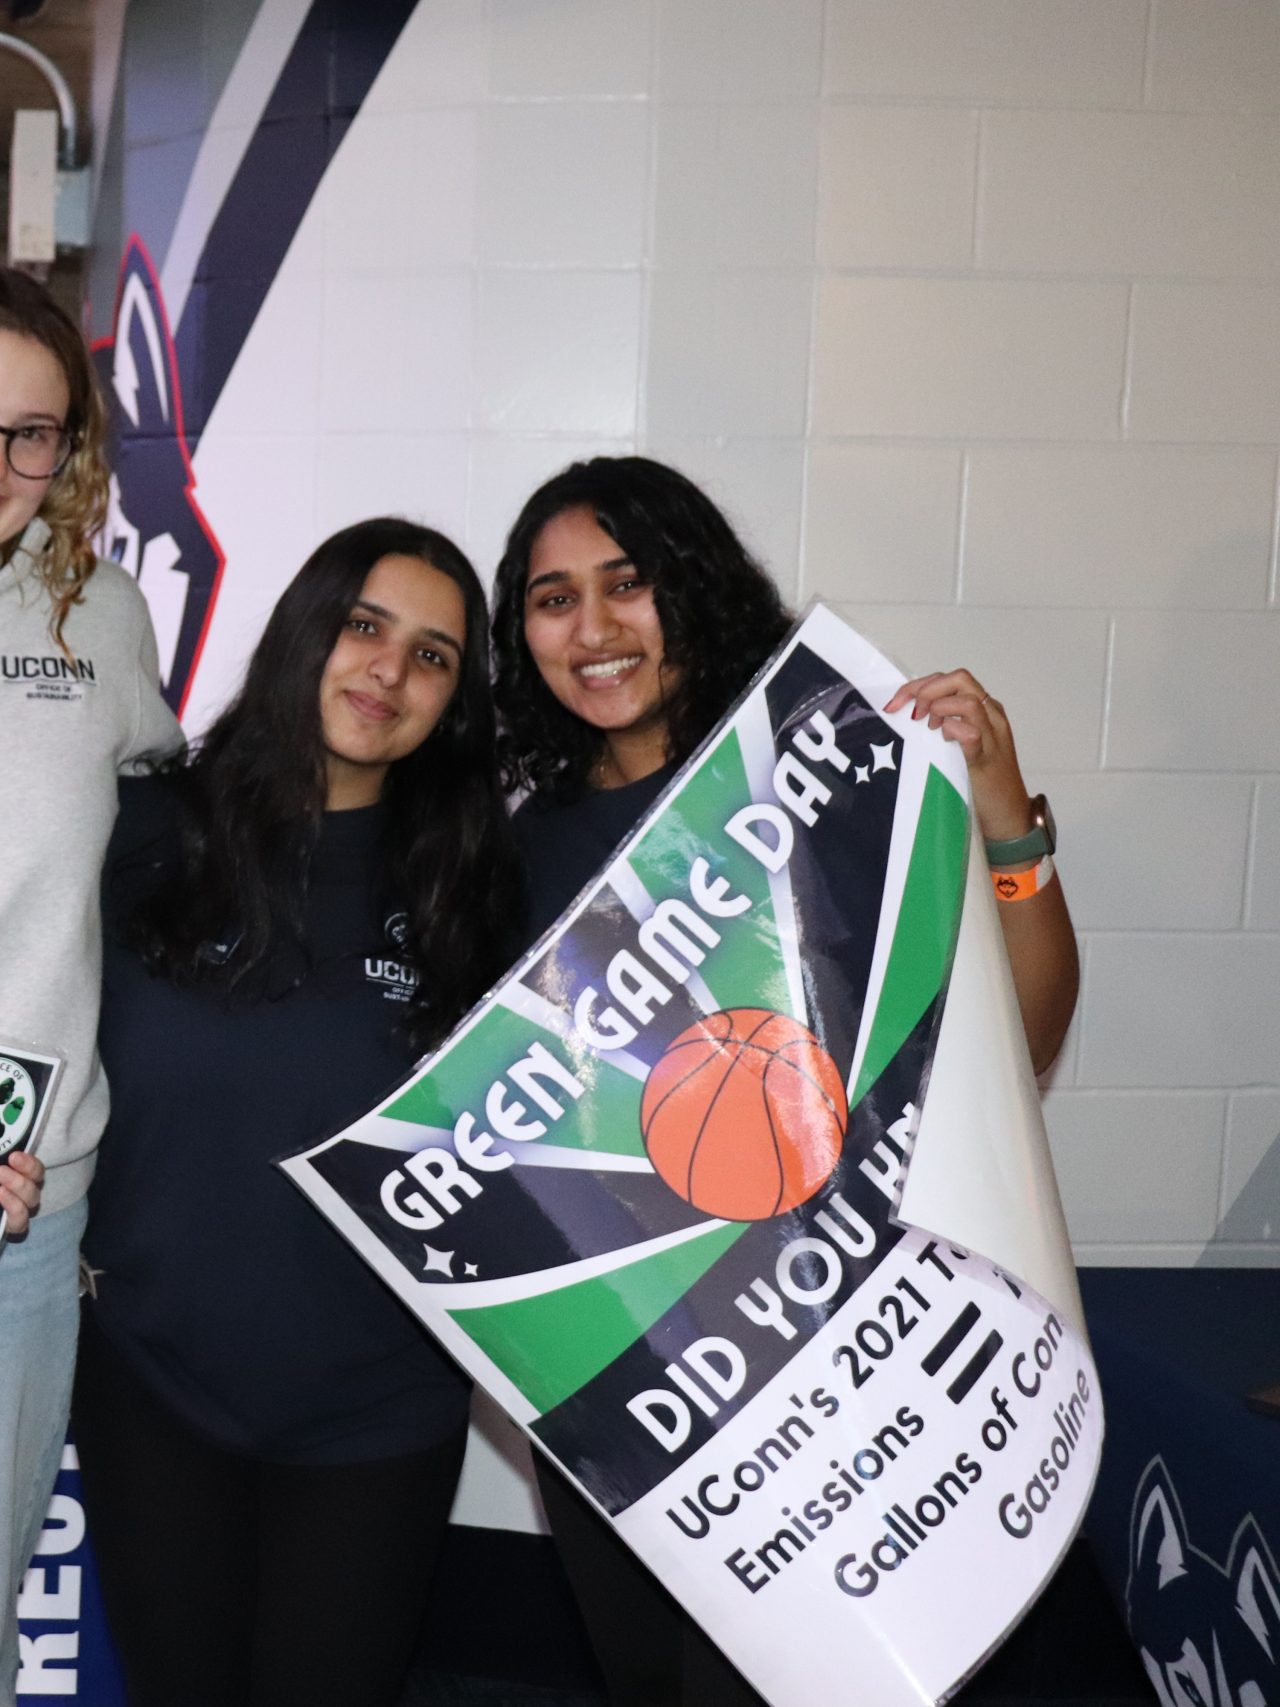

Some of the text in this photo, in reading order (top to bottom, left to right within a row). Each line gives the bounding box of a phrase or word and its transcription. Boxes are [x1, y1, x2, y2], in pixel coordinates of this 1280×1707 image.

[1, 655, 95, 681] UCONN
[365, 958, 420, 987] UCO
[380, 709, 852, 1231] GREEN GAME DAY
[12, 1069, 24, 1080] OF
[626, 1336, 748, 1454] DID
[734, 1192, 877, 1341] YOU
[665, 1394, 840, 1540] UConn's
[832, 1276, 931, 1389] 2021
[723, 1406, 926, 1594] Emissions
[834, 1313, 1064, 1598] Gallons of Con
[998, 1366, 1091, 1540] Gasoline
